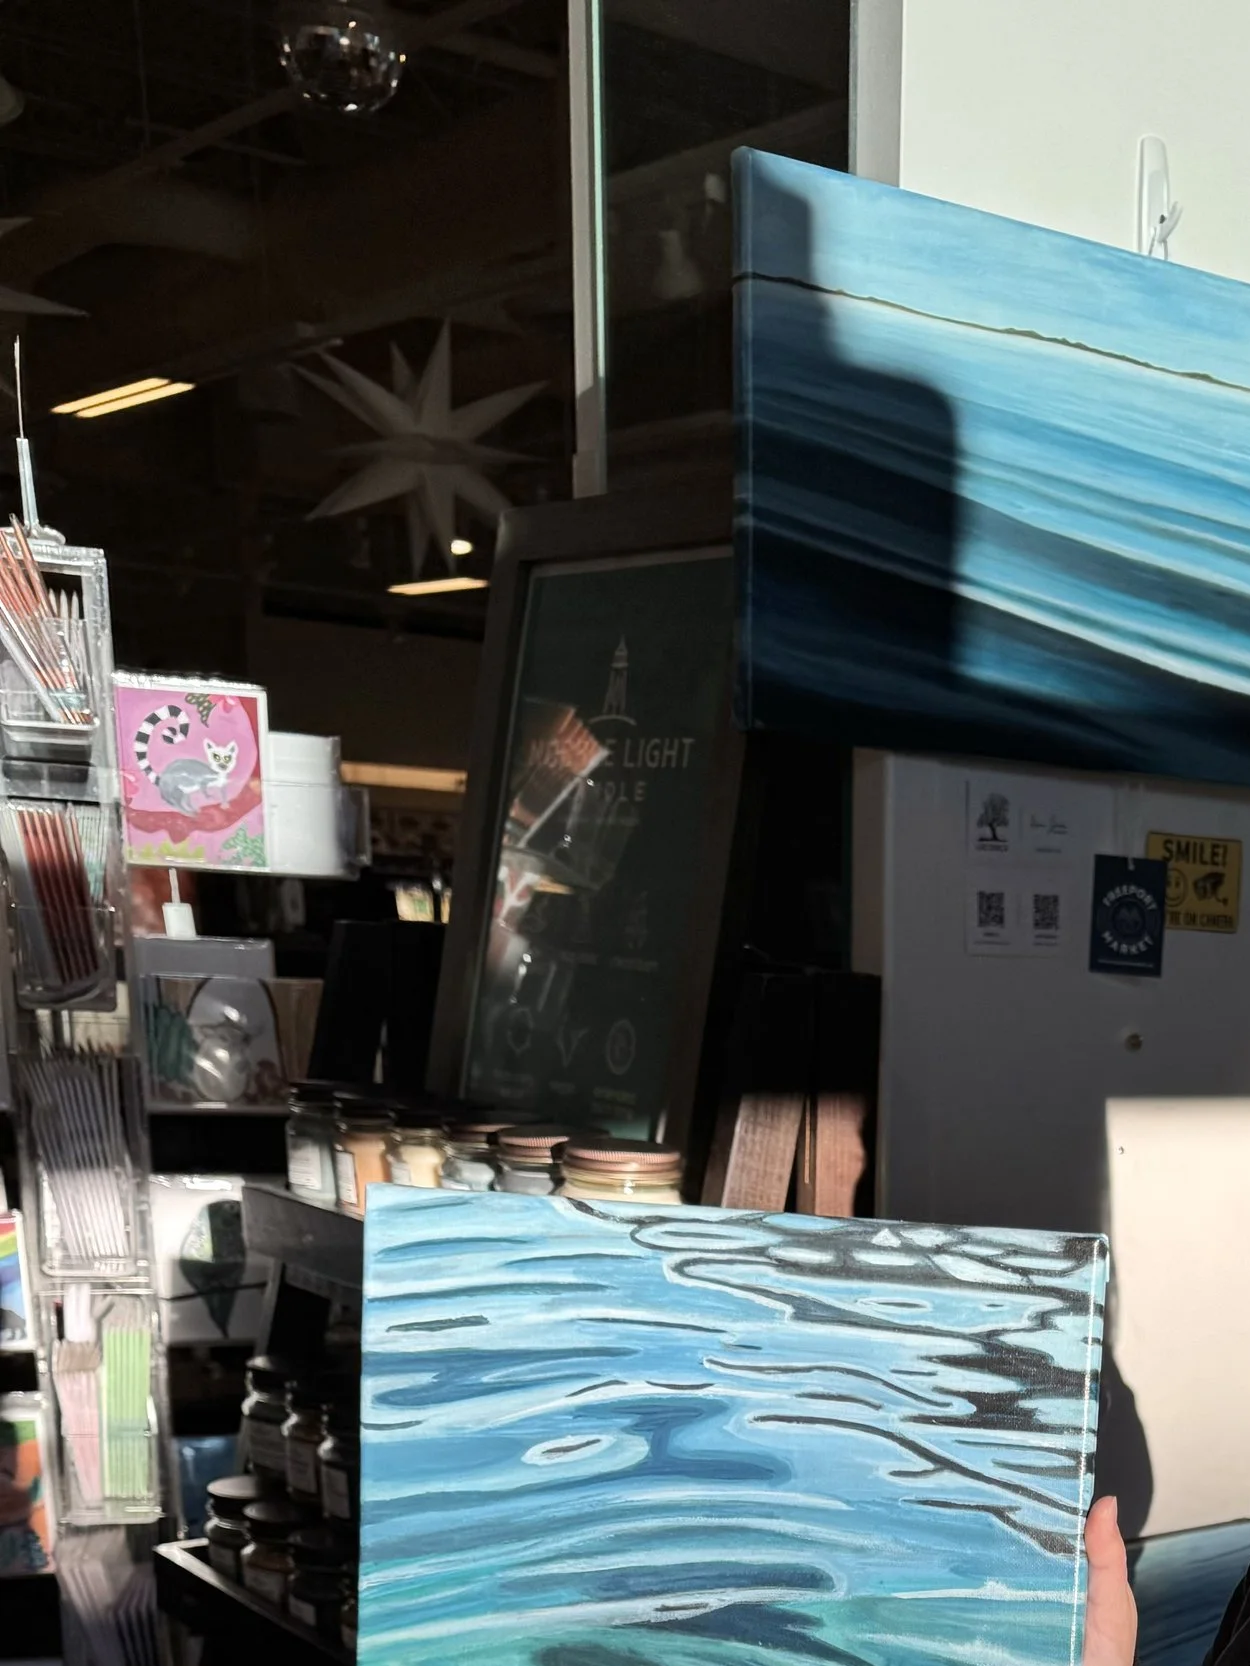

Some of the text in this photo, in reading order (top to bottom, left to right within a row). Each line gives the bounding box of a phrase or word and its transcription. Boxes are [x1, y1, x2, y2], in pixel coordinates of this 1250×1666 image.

[621, 737, 696, 769] LIGHT
[1162, 839, 1229, 868] SMILE!
[1101, 930, 1155, 956] MARKET
